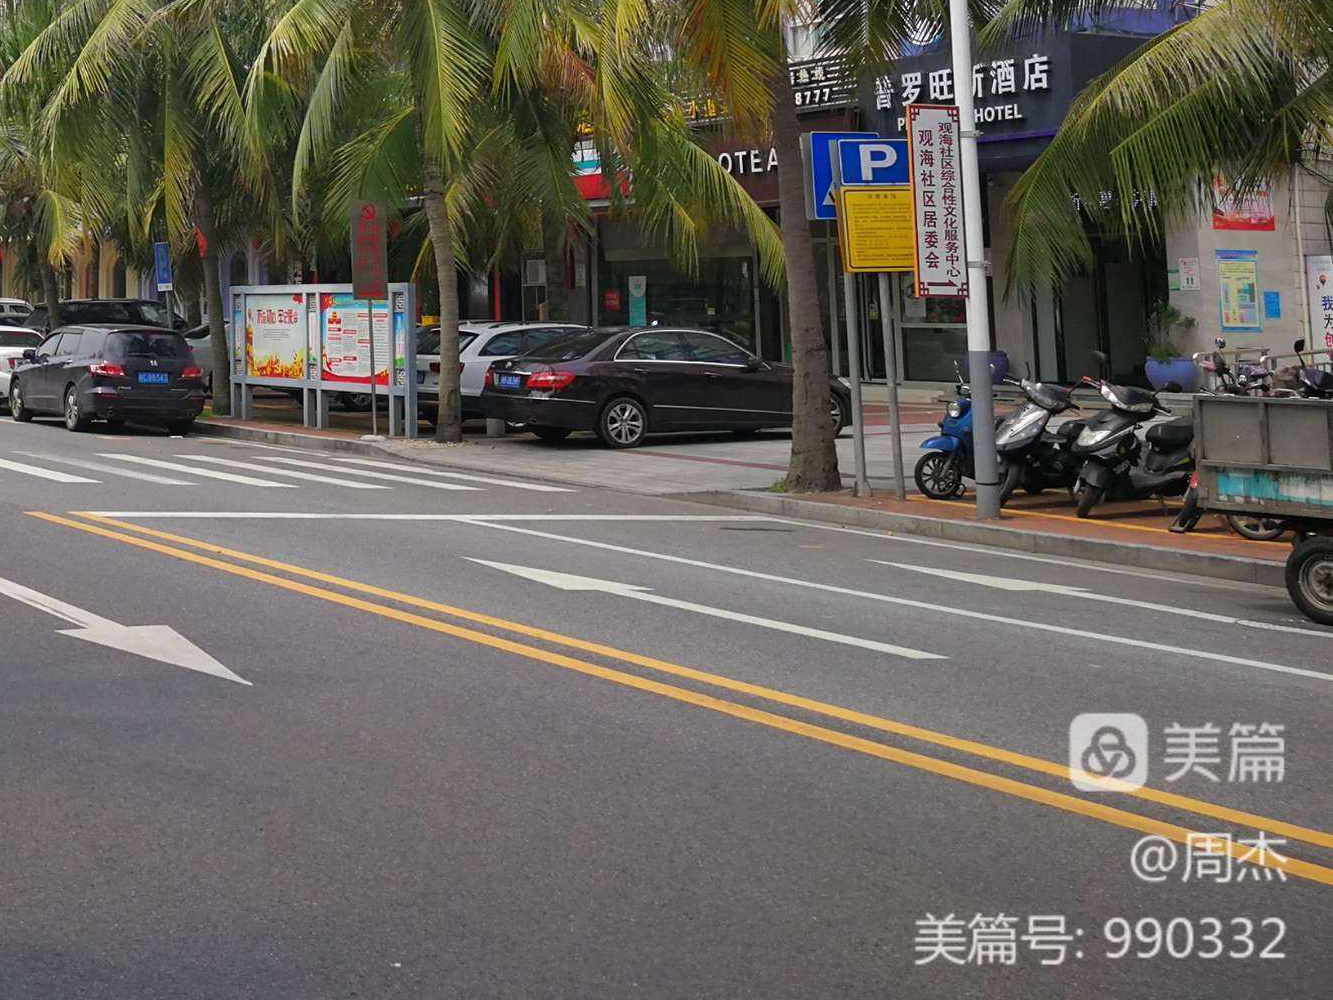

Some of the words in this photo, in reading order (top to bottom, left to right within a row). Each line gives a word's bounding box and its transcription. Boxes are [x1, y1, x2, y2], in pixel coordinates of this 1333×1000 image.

[795, 88, 830, 106] 8777
[974, 104, 1022, 123] HOTEL
[859, 144, 897, 181] P
[918, 130, 940, 269] 观海社区居委会
[938, 122, 961, 278] 观海社区综合性文化服务中心
